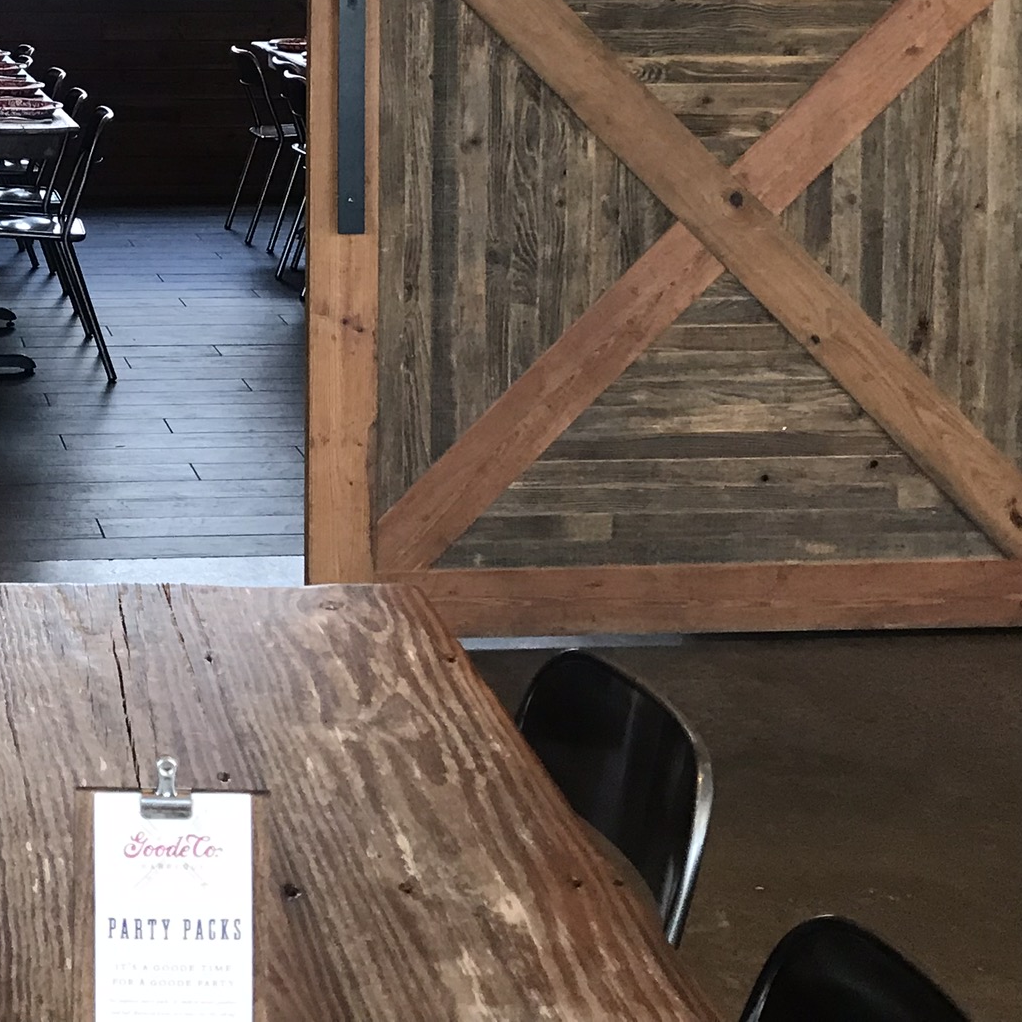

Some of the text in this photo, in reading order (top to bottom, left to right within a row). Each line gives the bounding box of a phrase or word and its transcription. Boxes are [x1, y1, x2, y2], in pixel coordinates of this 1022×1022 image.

[123, 831, 223, 858] Goode Co.
[108, 918, 241, 940] PARTY PACKS
[153, 964, 194, 972] GOODE
[201, 964, 232, 972] TIME
[112, 978, 133, 986] FOR
[139, 978, 145, 986] A
